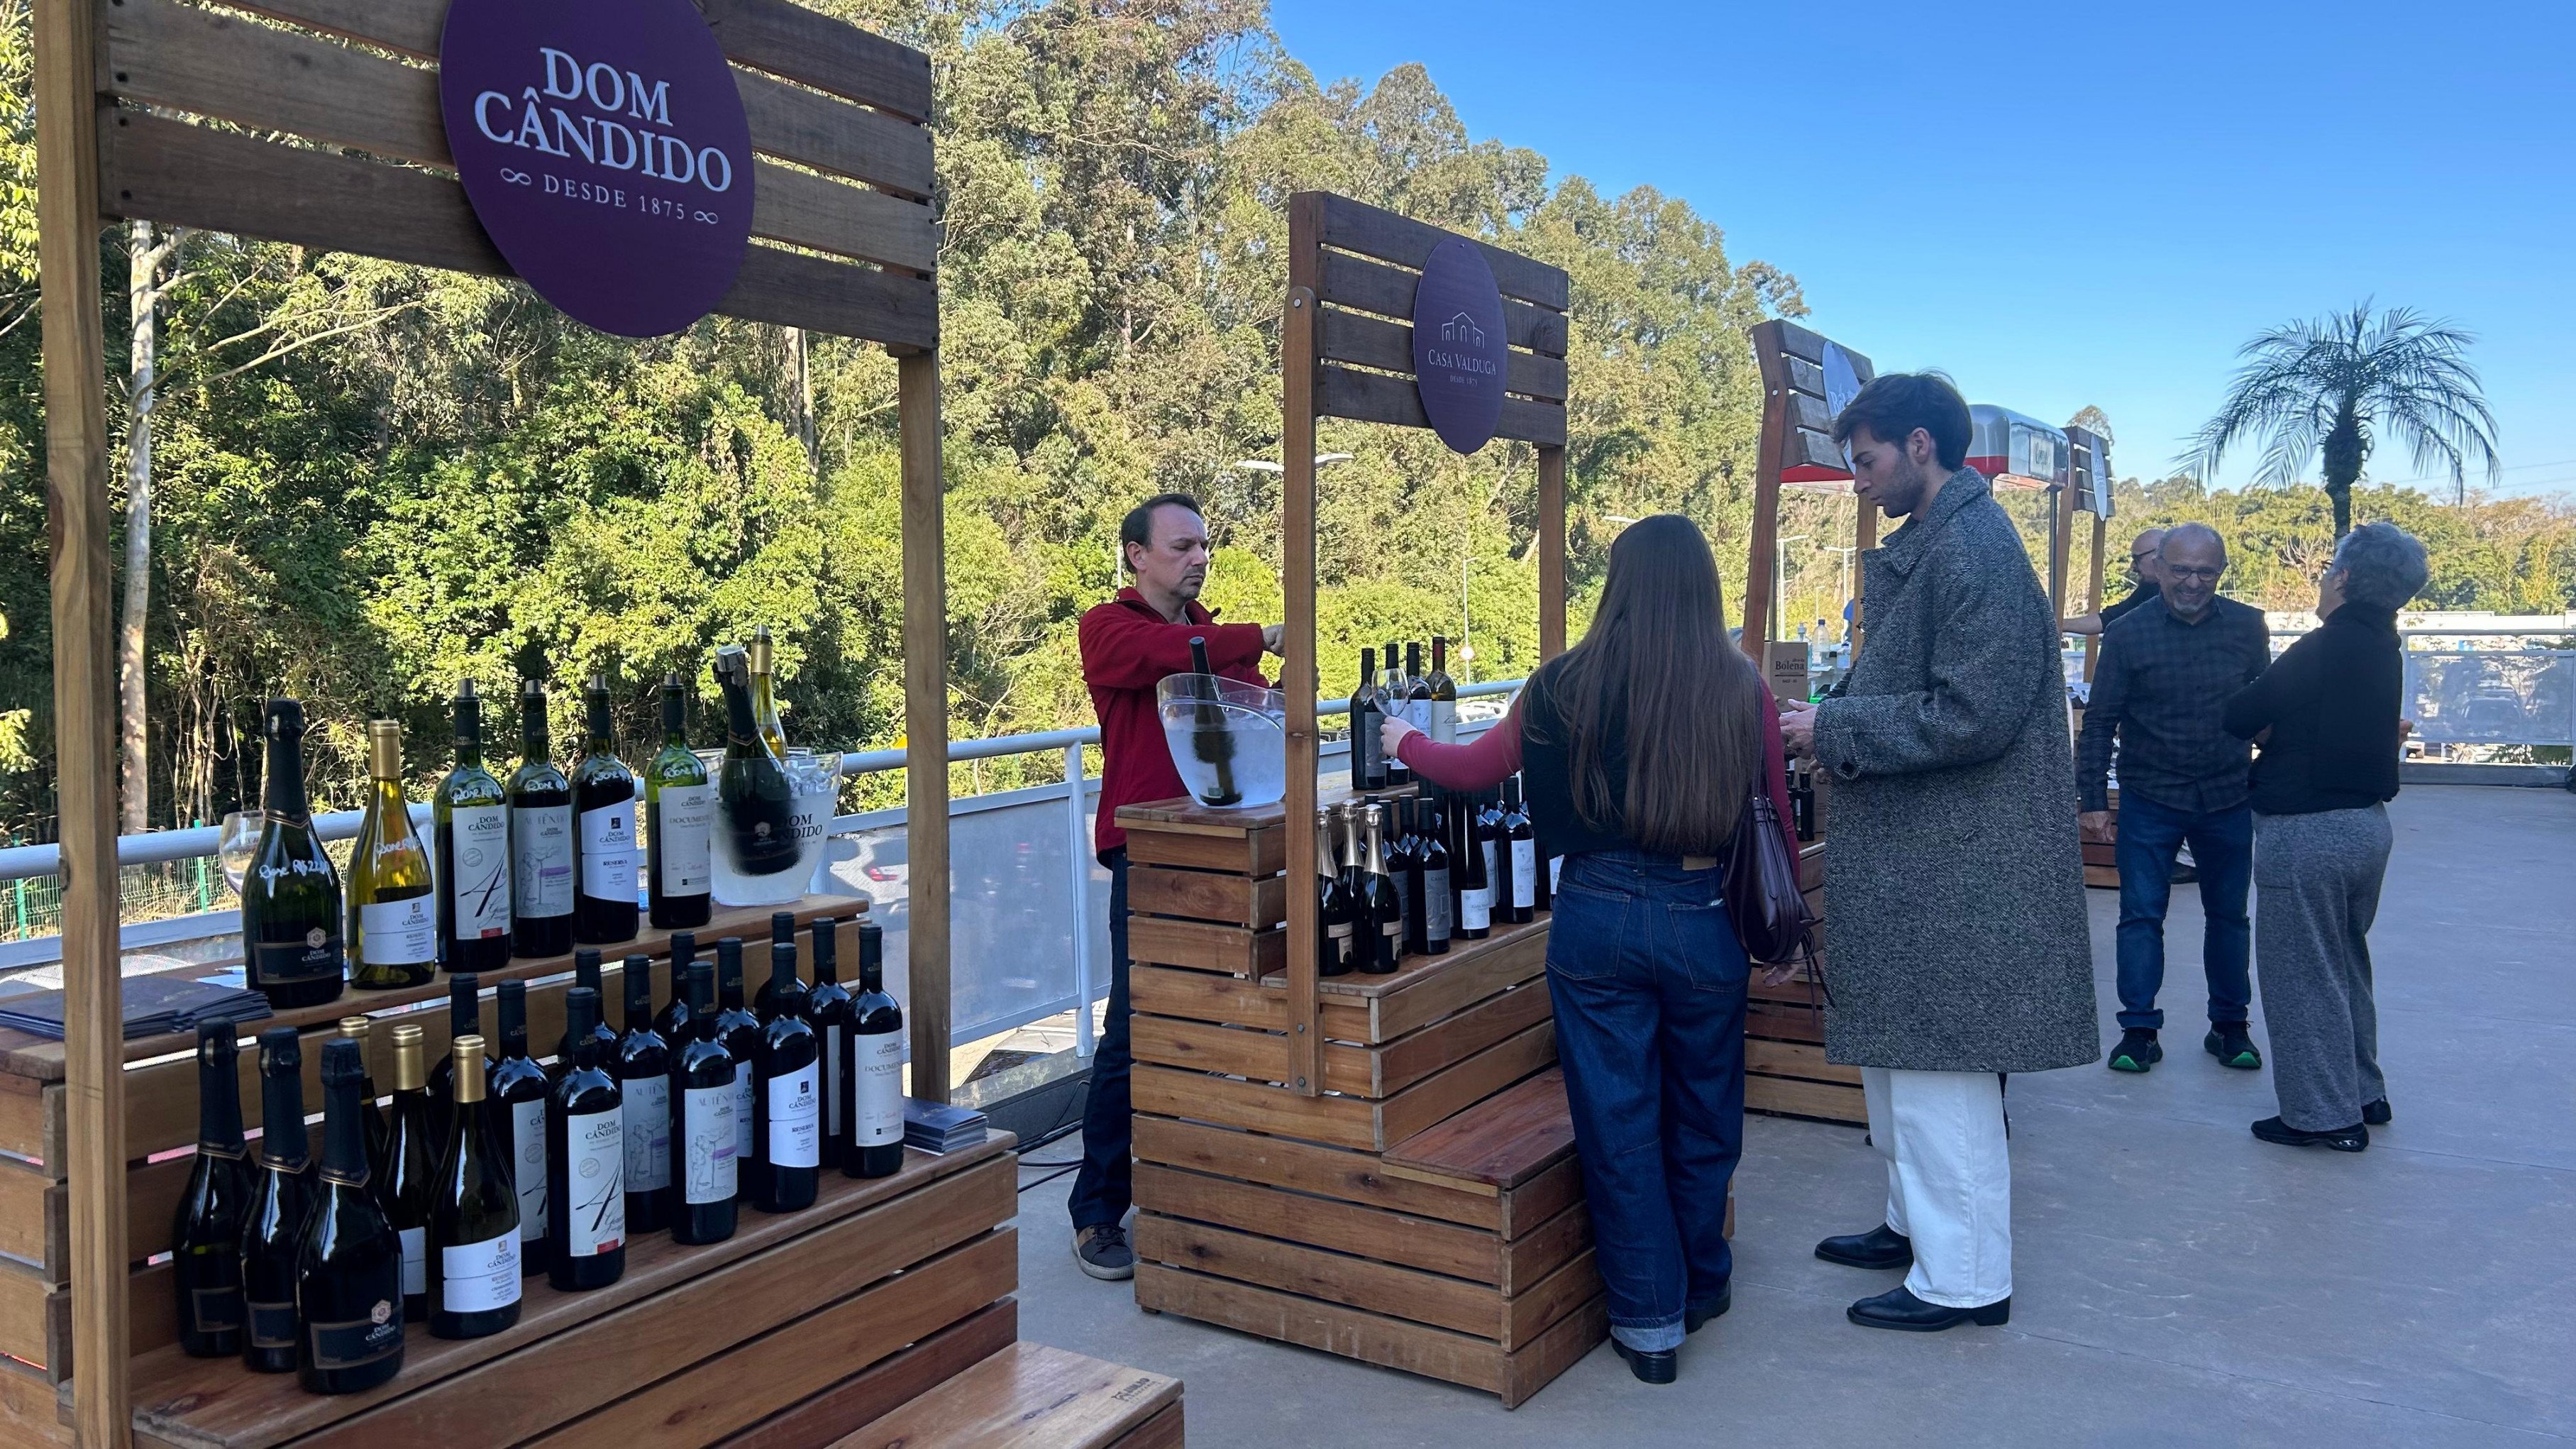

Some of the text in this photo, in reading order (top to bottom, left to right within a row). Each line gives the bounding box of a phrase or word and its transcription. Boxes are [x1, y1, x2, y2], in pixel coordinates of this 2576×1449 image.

[540, 47, 673, 126] DOM
[475, 87, 731, 192] CÂNDIDO
[543, 174, 685, 220] DESDE 1875
[1428, 349, 1496, 375] CASA VALDUGA
[1449, 375, 1465, 384] DESDE
[1775, 660, 1805, 671] Bolena
[480, 815, 499, 824] DOM
[597, 1119, 617, 1130] DOM
